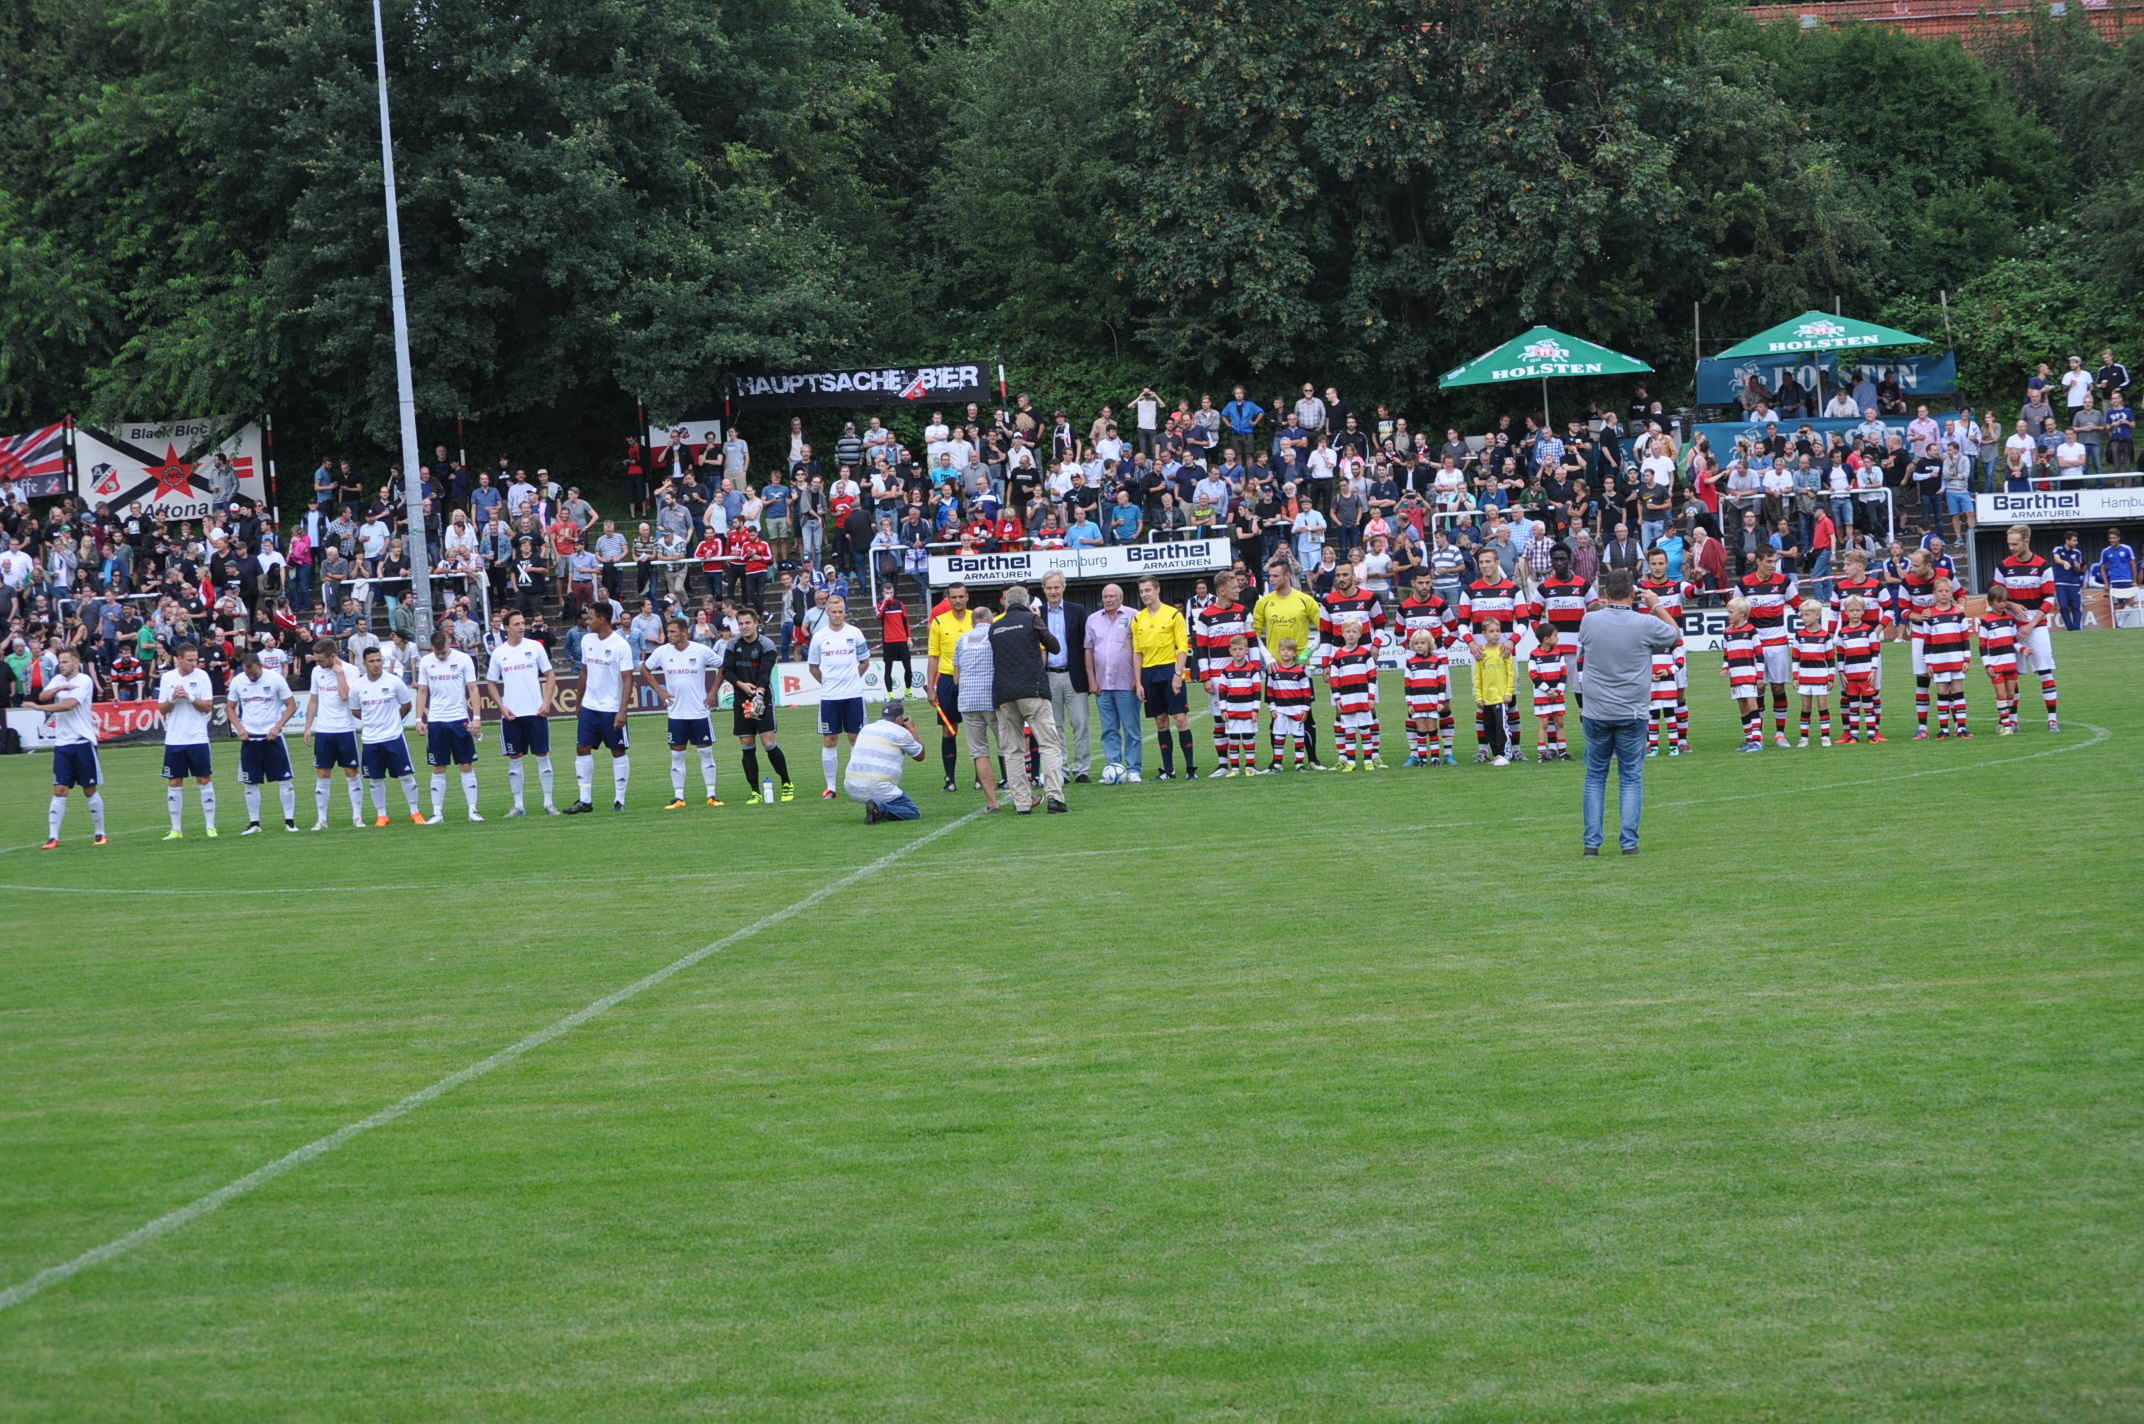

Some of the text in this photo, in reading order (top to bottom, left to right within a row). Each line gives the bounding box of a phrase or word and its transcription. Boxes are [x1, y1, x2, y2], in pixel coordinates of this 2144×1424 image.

[1768, 335, 1879, 351] HOLSTEN
[1492, 363, 1602, 380] HOLSTEN
[737, 365, 978, 397] HAUPTSACHE BIER
[175, 425, 208, 437] Bloc
[1993, 493, 2080, 511] Barthel
[2011, 509, 2081, 519] ARMATUREN
[1127, 542, 1211, 562] Barthel
[948, 554, 1108, 572] Barthel Hamburg
[1143, 558, 1212, 570] ARMATUREN
[963, 570, 1032, 581] ARMATUREN
[92, 709, 168, 734] ALTON
